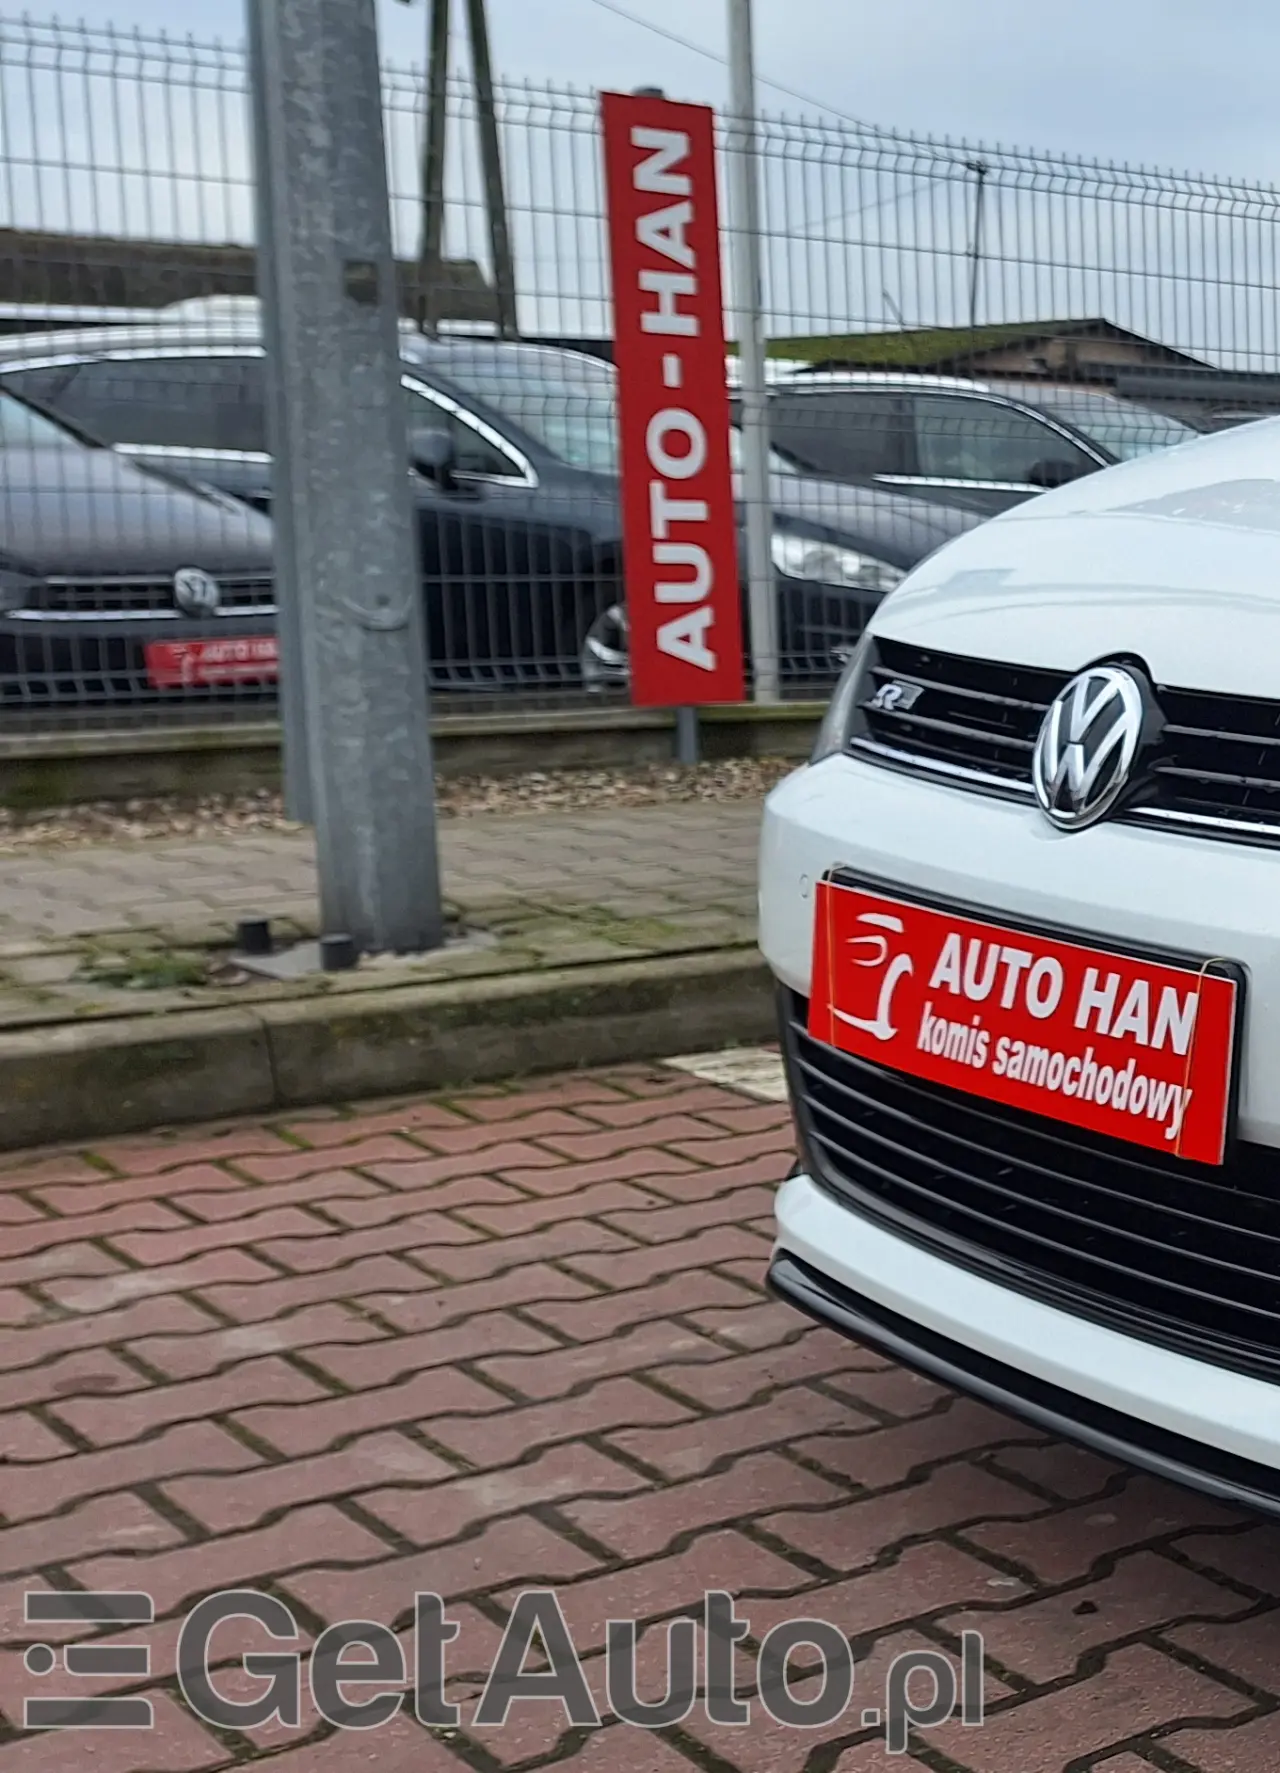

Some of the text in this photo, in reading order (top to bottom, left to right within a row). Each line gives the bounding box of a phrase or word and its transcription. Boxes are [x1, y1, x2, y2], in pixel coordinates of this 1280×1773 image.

[630, 125, 699, 338] HAN
[645, 407, 716, 672] AUTO
[917, 1000, 1193, 1140] komis samochodowy
[929, 932, 1200, 1056] AUTO HAN
